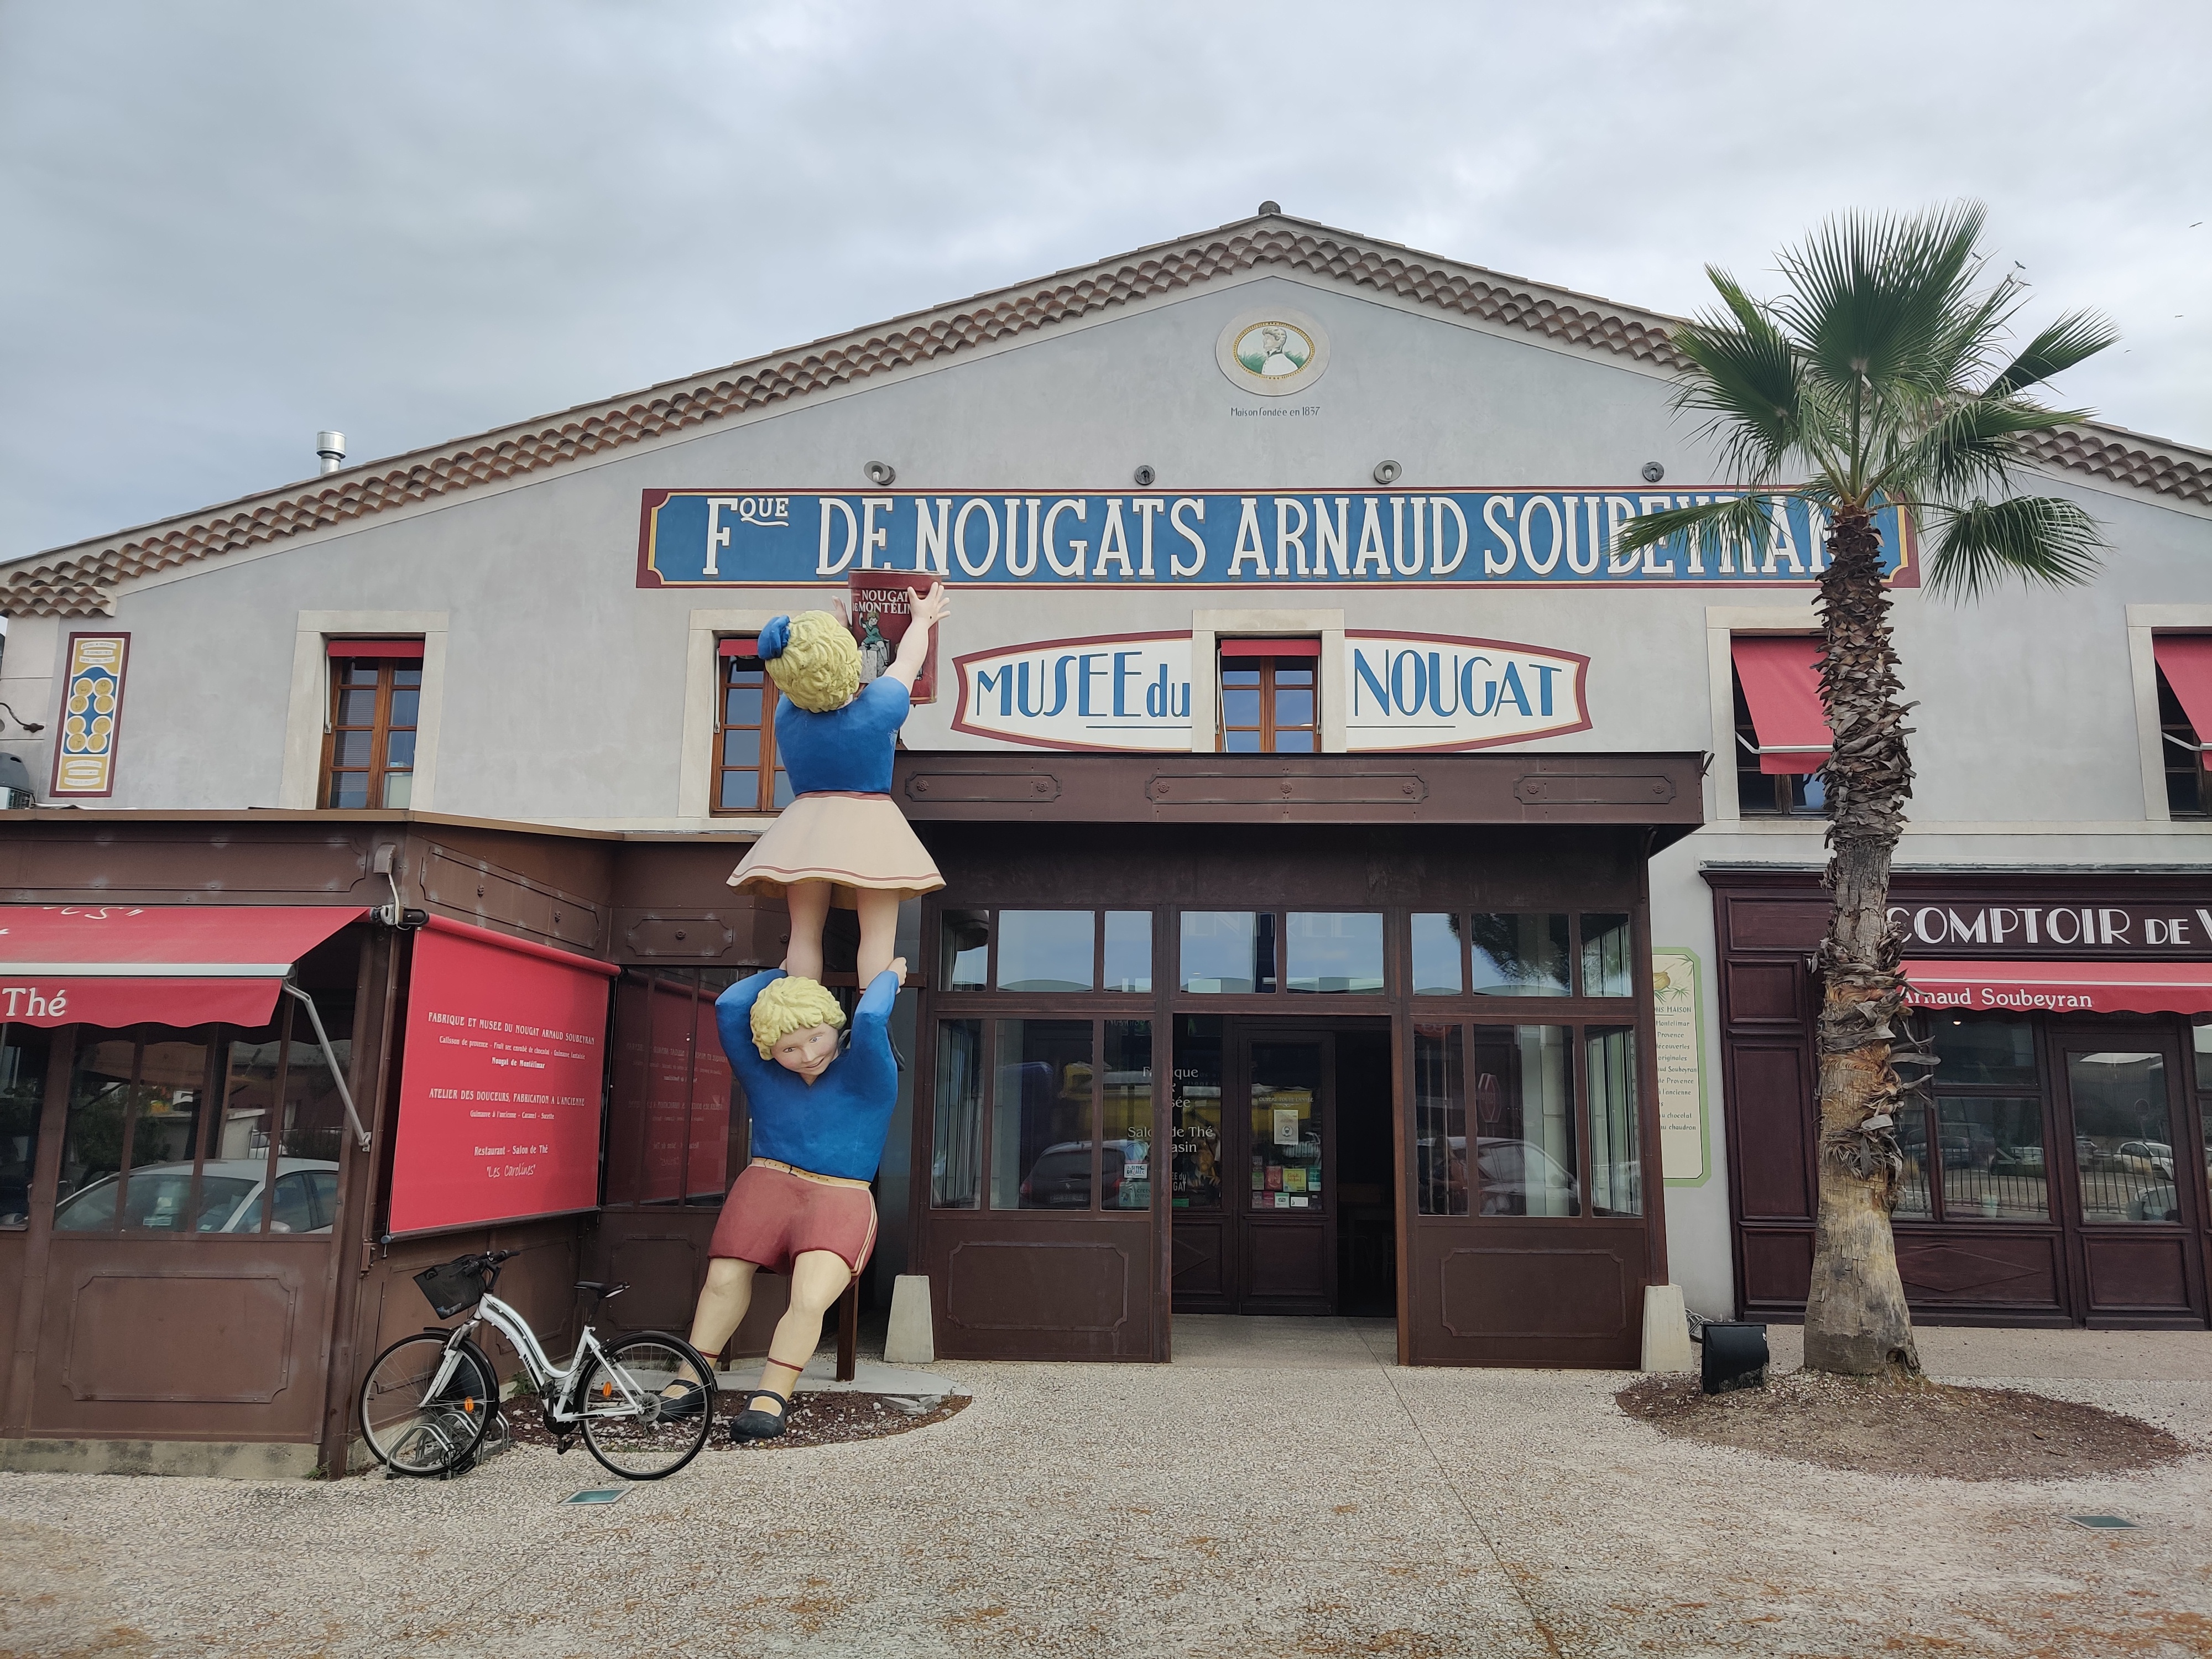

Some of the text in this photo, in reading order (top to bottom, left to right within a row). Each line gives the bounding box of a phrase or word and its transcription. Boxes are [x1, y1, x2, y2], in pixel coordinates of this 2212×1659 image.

[1230, 407, 1258, 416] Maison
[1259, 407, 1287, 416] fondée
[1302, 406, 1321, 416] 1837
[816, 497, 894, 575] DE
[913, 497, 1206, 577] NOUGATS
[1227, 496, 1468, 576] ARNAUD
[1146, 663, 1190, 717] du
[1353, 648, 1562, 717] NOUGAT
[1886, 907, 2131, 945] COMPTOIR
[2145, 919, 2191, 945] DE
[2, 987, 67, 1017] Thé
[1981, 987, 2093, 1010] Soubeyran
[428, 1011, 595, 1045] FABRIQUE ET MUSEE DU NOUGAT ARNAUD SOUBEYRAN
[439, 1035, 460, 1045] Calisson
[491, 1057, 509, 1067] Nougat
[1668, 1066, 1697, 1074] Soubeyran
[429, 1088, 458, 1099] ATELIER
[460, 1090, 474, 1100] DES
[513, 1093, 549, 1104] FABRICATION
[551, 1095, 555, 1104] A
[1188, 1125, 1213, 1138] Thé
[474, 1144, 548, 1156] Restaurant Salon de Thé
